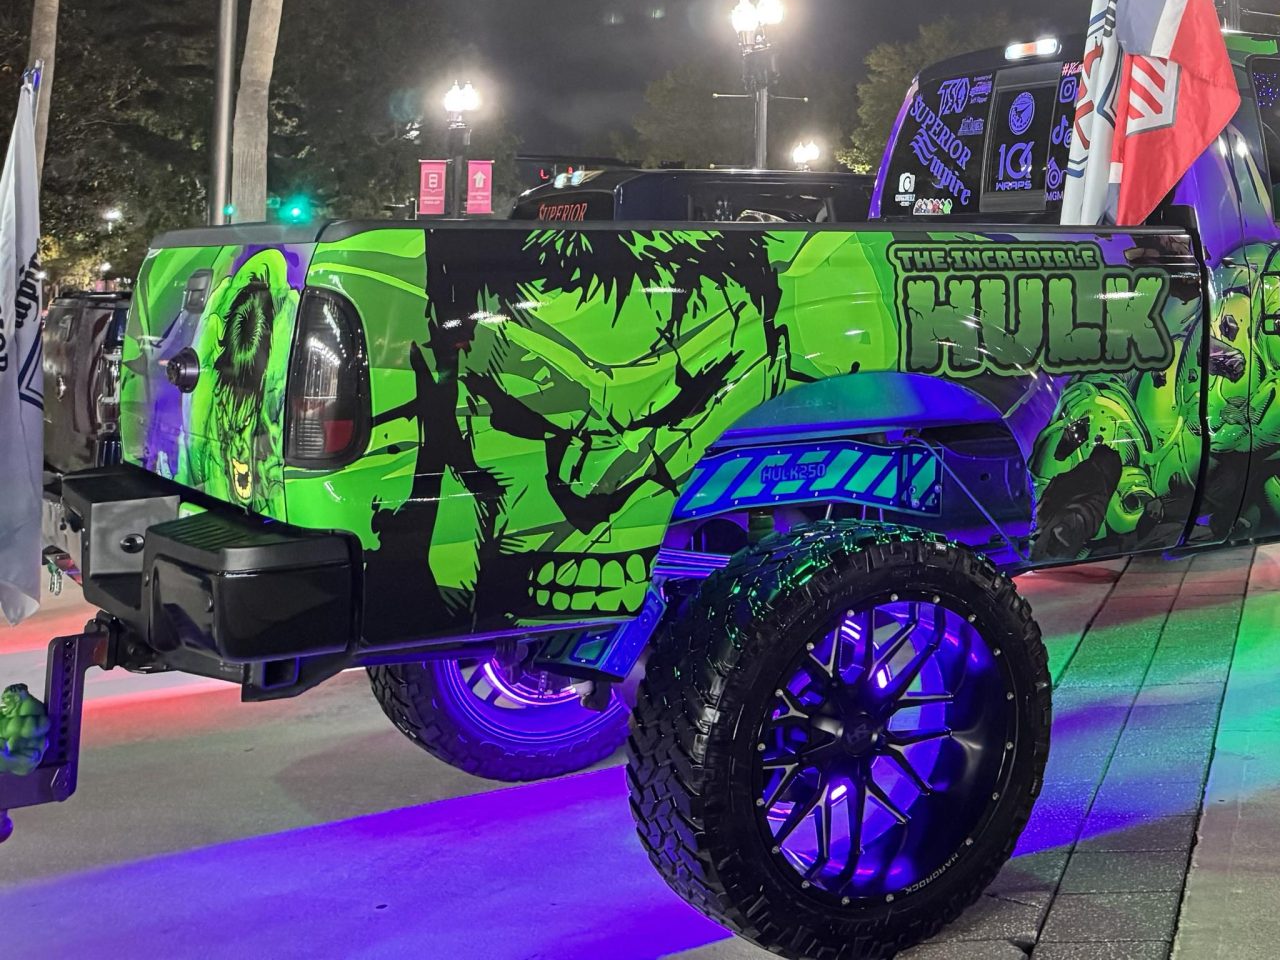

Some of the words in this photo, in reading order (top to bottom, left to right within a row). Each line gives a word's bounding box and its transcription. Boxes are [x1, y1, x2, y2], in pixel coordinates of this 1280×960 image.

[910, 93, 972, 171] SUPERIOR
[909, 128, 972, 206] Empire
[996, 181, 1032, 191] WRAPS
[897, 249, 948, 270] THE
[950, 249, 1099, 269] INCREDIBLE
[906, 276, 1168, 370] HULK
[762, 463, 827, 482] HULK250
[904, 852, 959, 895] HARDROCK
